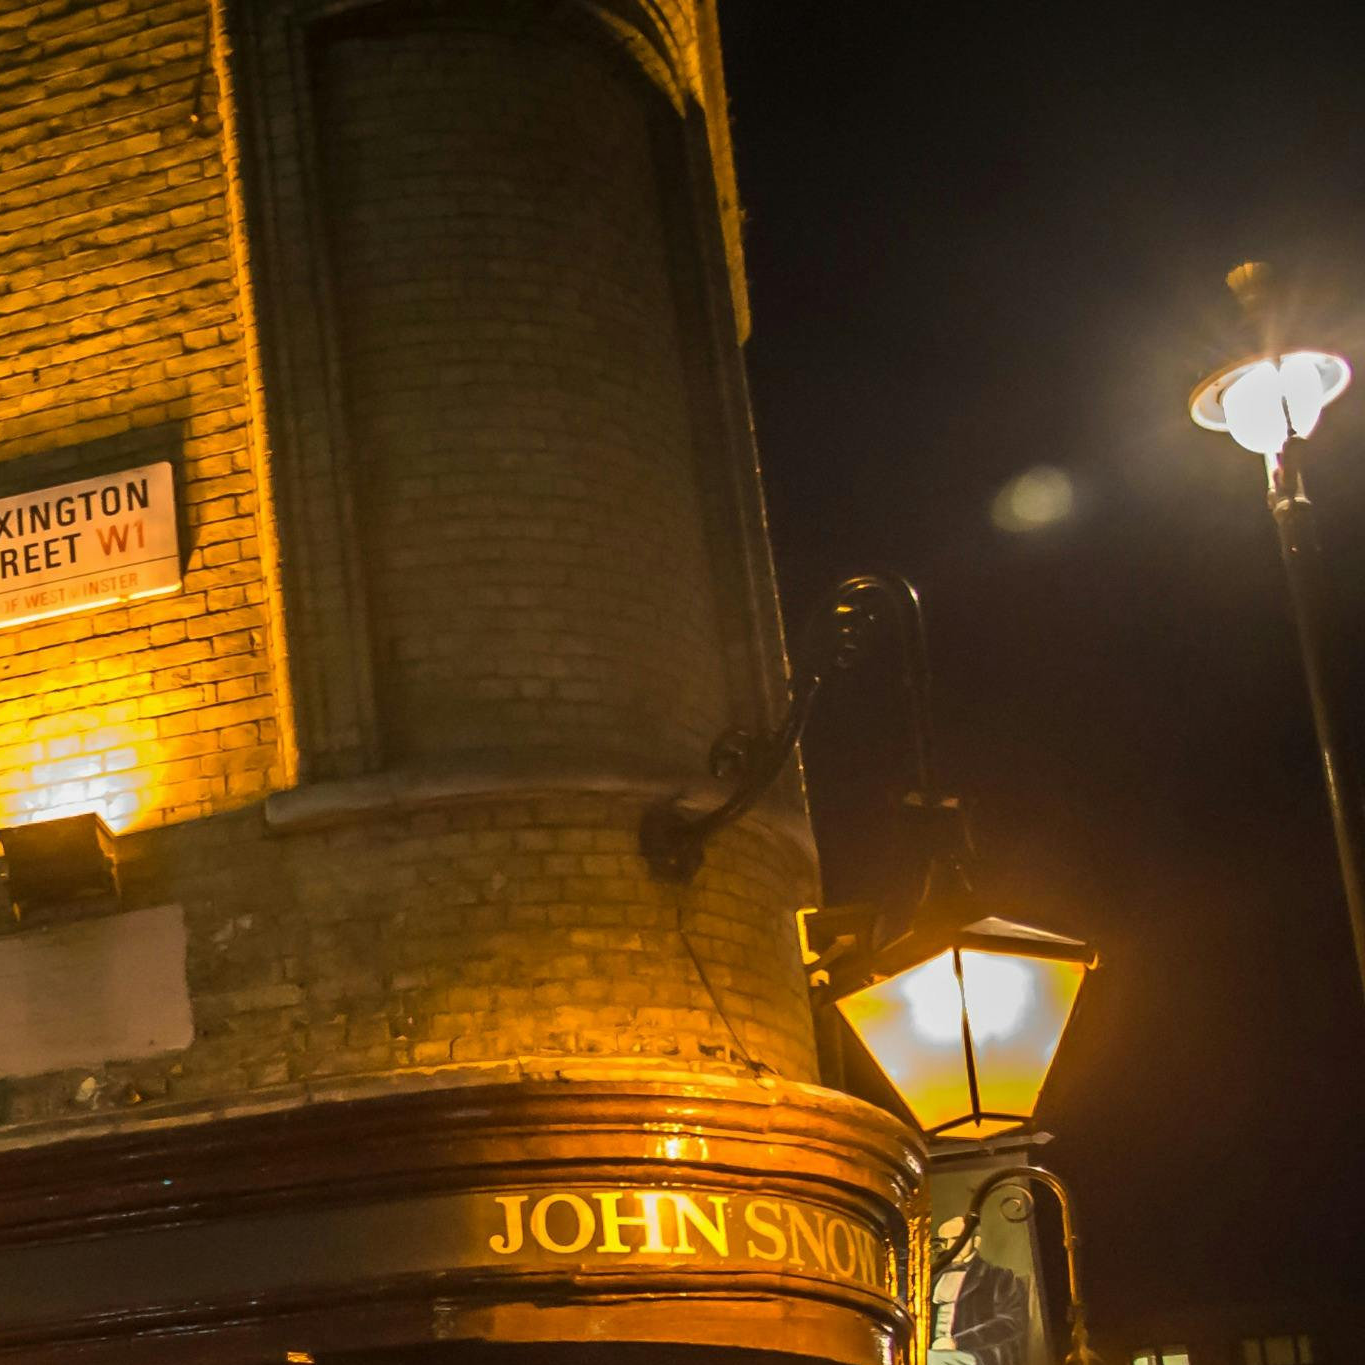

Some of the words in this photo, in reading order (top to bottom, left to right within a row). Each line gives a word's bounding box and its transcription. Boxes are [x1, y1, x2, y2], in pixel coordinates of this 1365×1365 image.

[95, 519, 146, 556] W1
[23, 573, 139, 609] WESTINSTER
[488, 1191, 730, 1258] JOHN
[744, 1198, 877, 1288] SNOW
